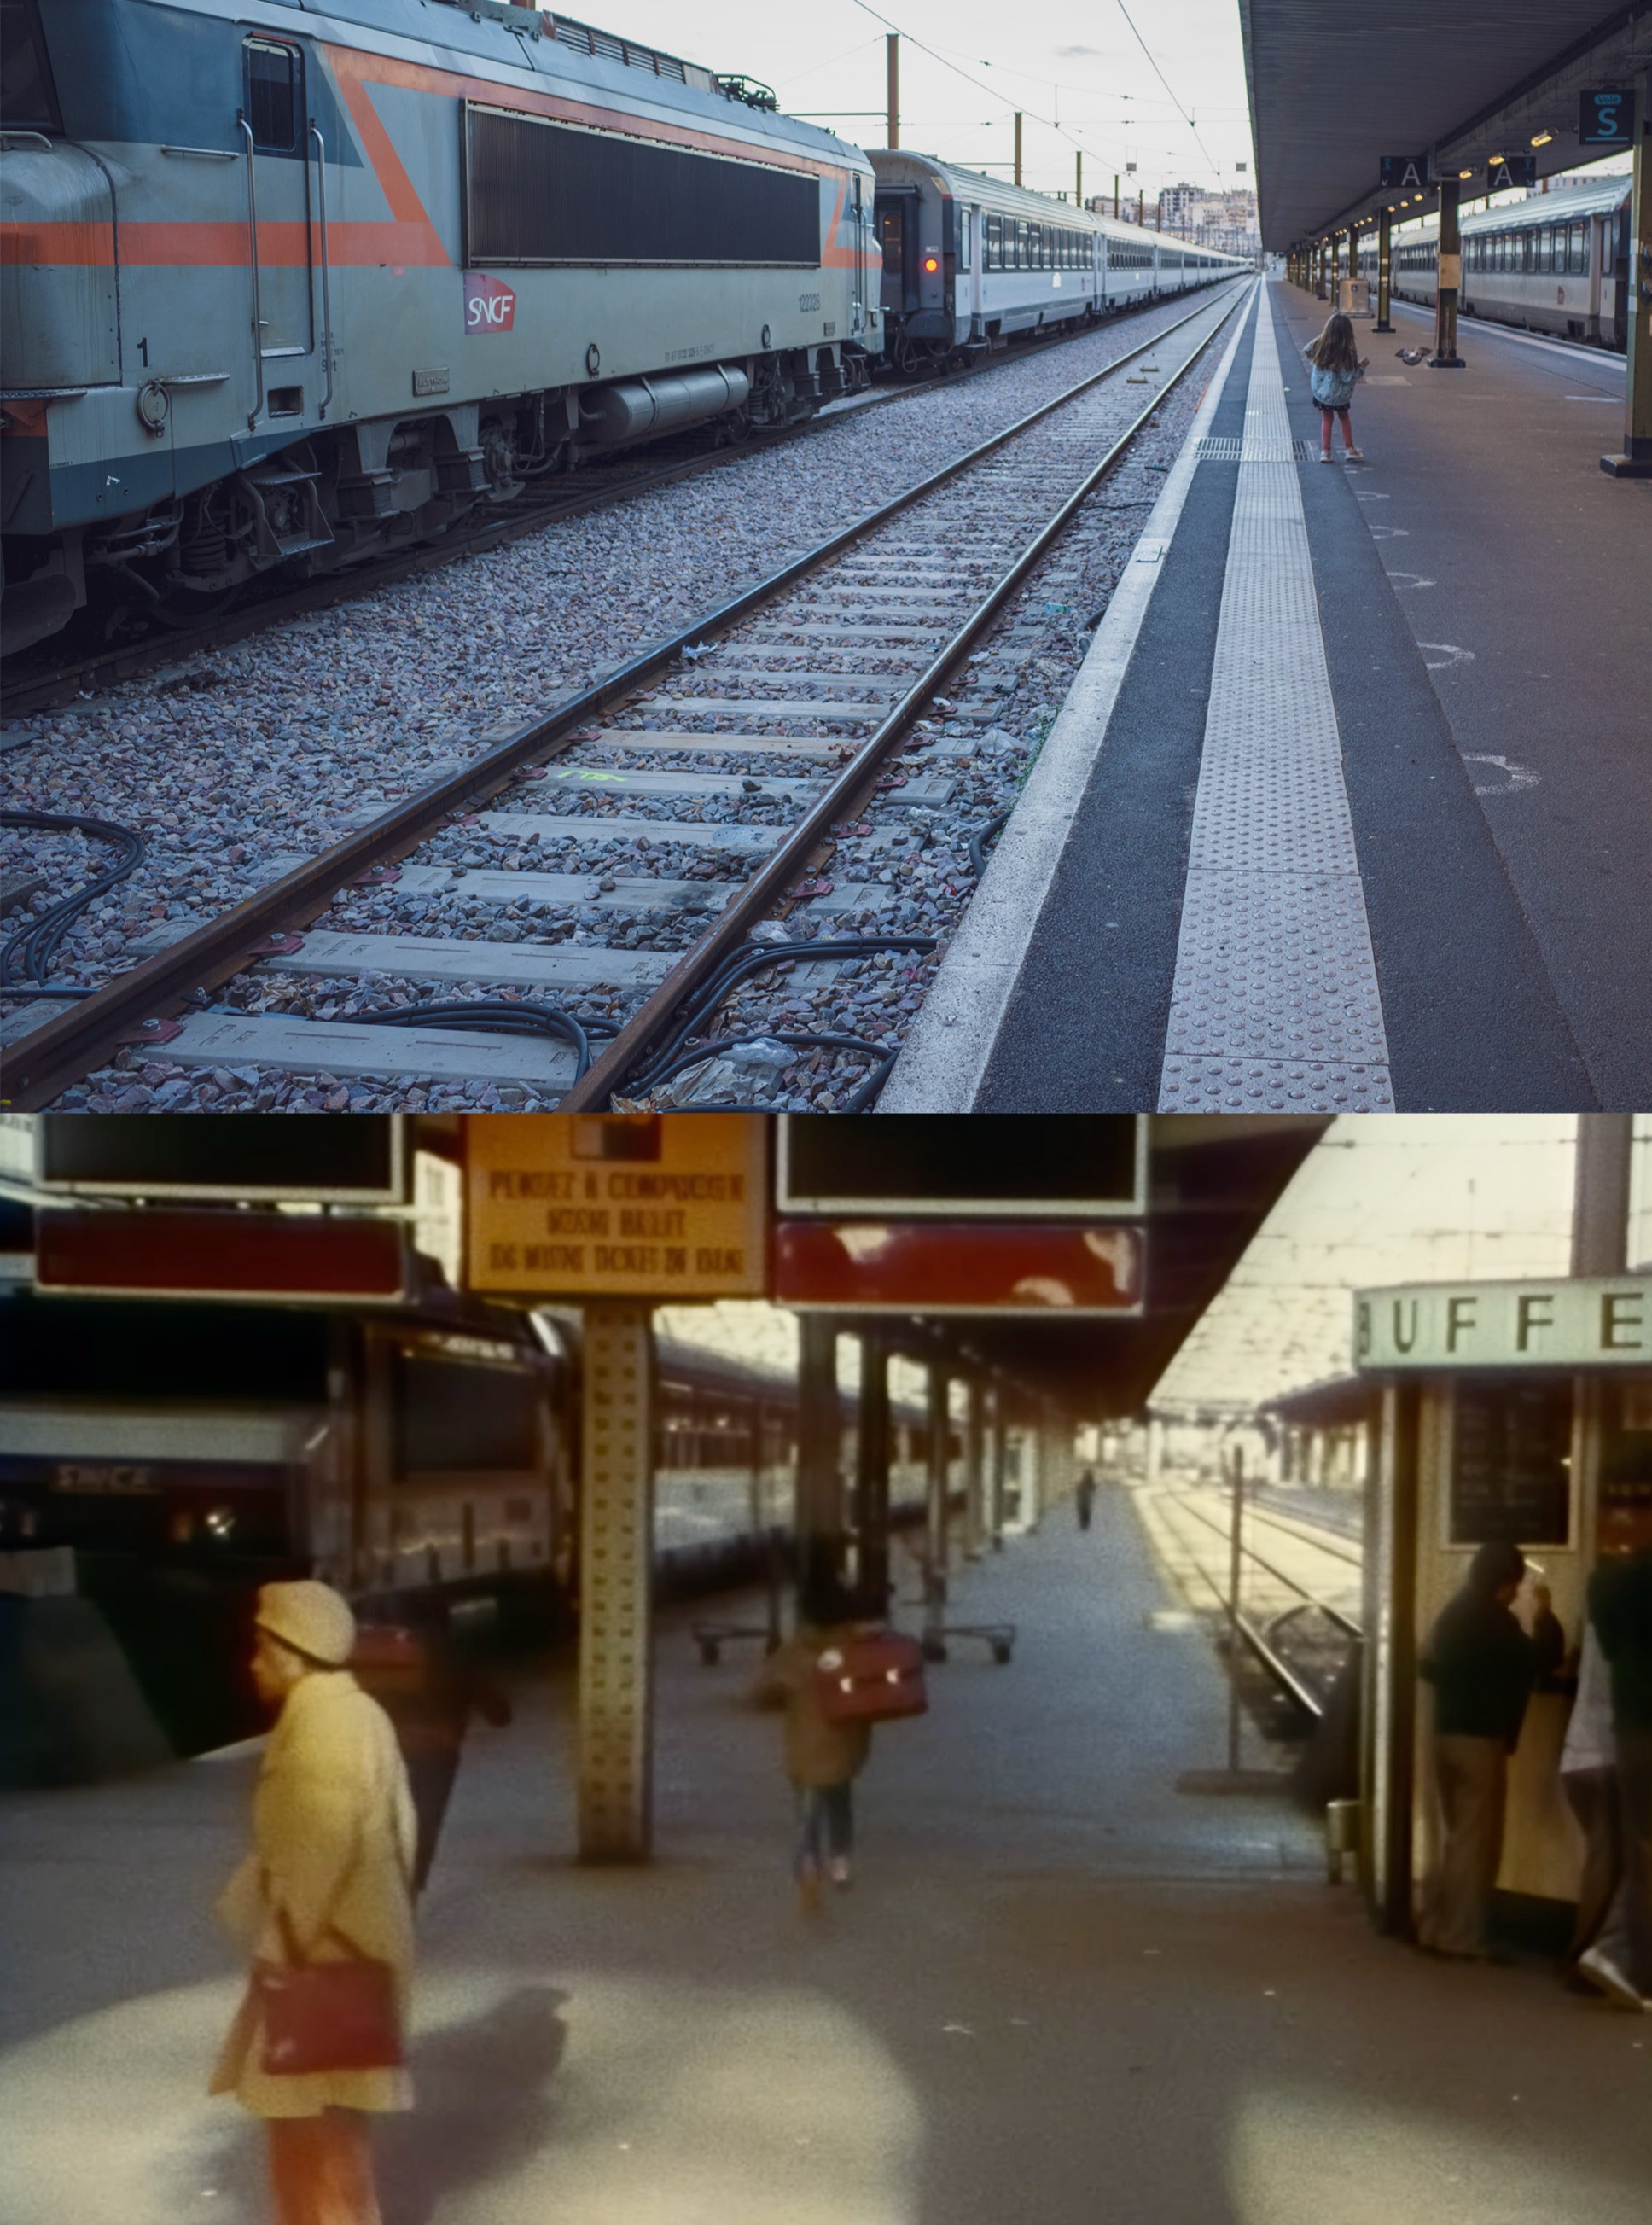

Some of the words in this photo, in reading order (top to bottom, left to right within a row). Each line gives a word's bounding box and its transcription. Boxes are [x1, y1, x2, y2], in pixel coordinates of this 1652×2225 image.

[1597, 94, 1619, 103] Voie
[1597, 108, 1618, 136] S
[1401, 162, 1421, 186] A
[1494, 162, 1514, 186] A
[468, 295, 514, 325] SNCF
[137, 337, 148, 368] 1
